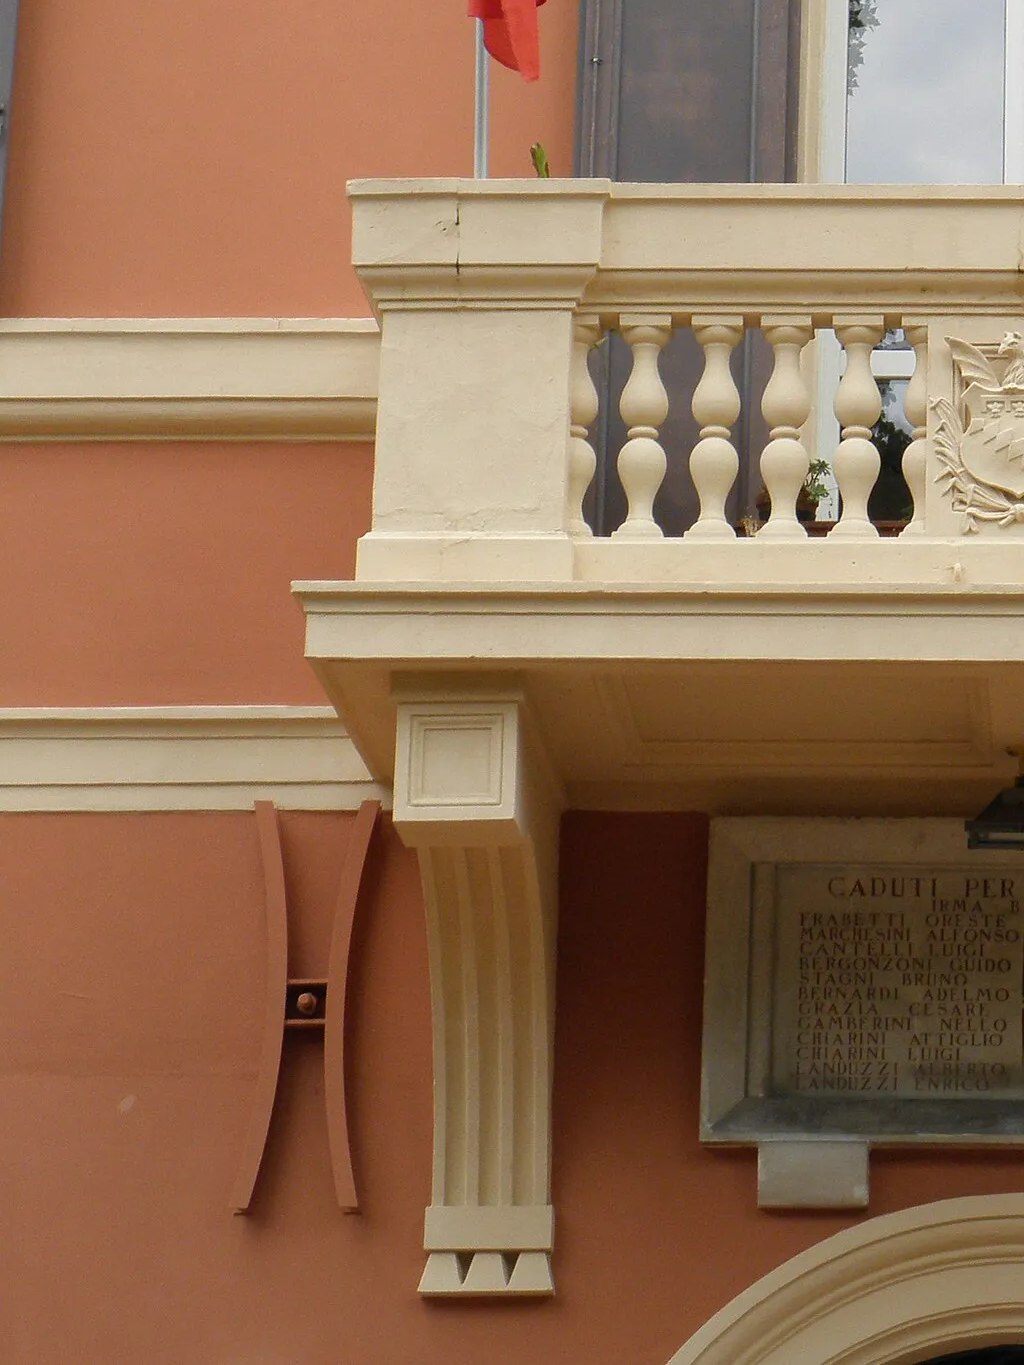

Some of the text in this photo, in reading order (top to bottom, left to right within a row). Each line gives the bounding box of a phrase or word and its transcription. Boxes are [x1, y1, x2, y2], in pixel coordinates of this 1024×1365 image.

[828, 877, 937, 898] CADUTI
[965, 878, 1015, 899] PER
[932, 900, 983, 913] IRMA
[800, 912, 1006, 928] FRABETTI ORESTE
[800, 927, 1019, 943] MARCHESINI ALFONSO
[800, 942, 985, 957] CANTELLI LUIGI
[799, 957, 1011, 972] BERGONZONI GUIDO
[800, 973, 968, 986] STAGNI BRUNO
[798, 988, 1009, 1002] BERNARDI ADELMO
[798, 1002, 990, 1016] GRAZIA CESARE
[798, 1017, 1007, 1032] GAMBERINI NELLO
[797, 1033, 887, 1046] CHIARINI
[796, 1048, 960, 1061] CHIARINI LUIGI
[796, 1062, 1006, 1076] LANDUZZI ALBERTO
[796, 1077, 989, 1091] LANDUZZI ENRICO
